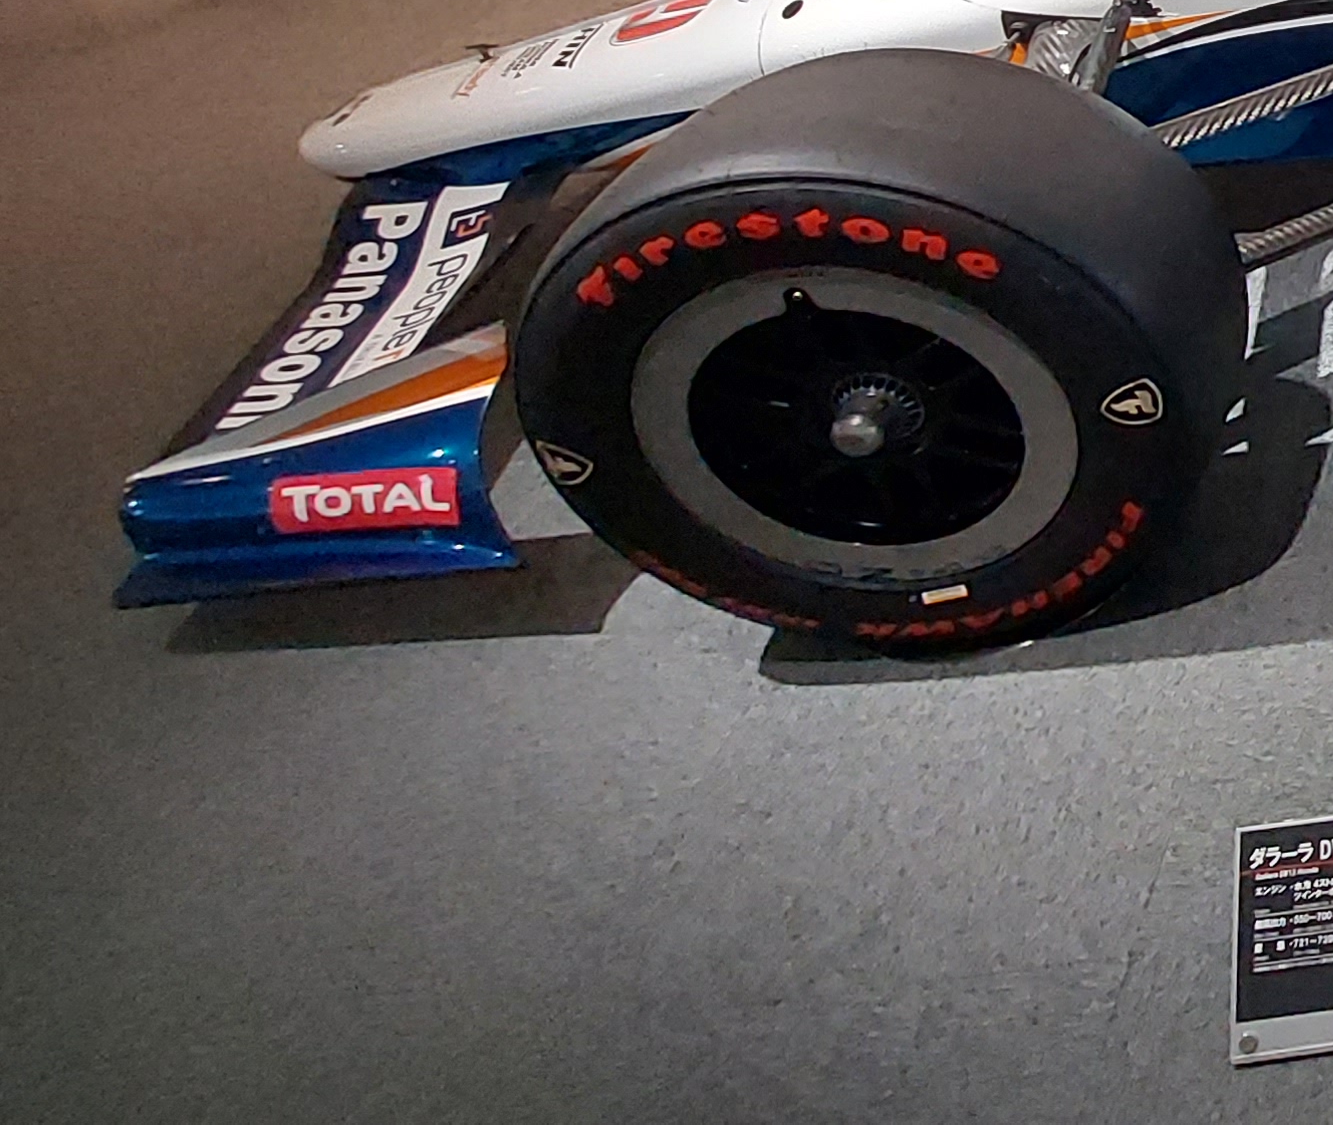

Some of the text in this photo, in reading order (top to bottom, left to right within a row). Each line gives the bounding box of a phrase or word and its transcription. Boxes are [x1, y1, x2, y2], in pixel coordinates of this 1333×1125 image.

[576, 205, 1000, 307] Firestone
[215, 201, 428, 430] Panasoni
[281, 474, 451, 522] TOTAL
[1249, 842, 1315, 870] ダラーラ
